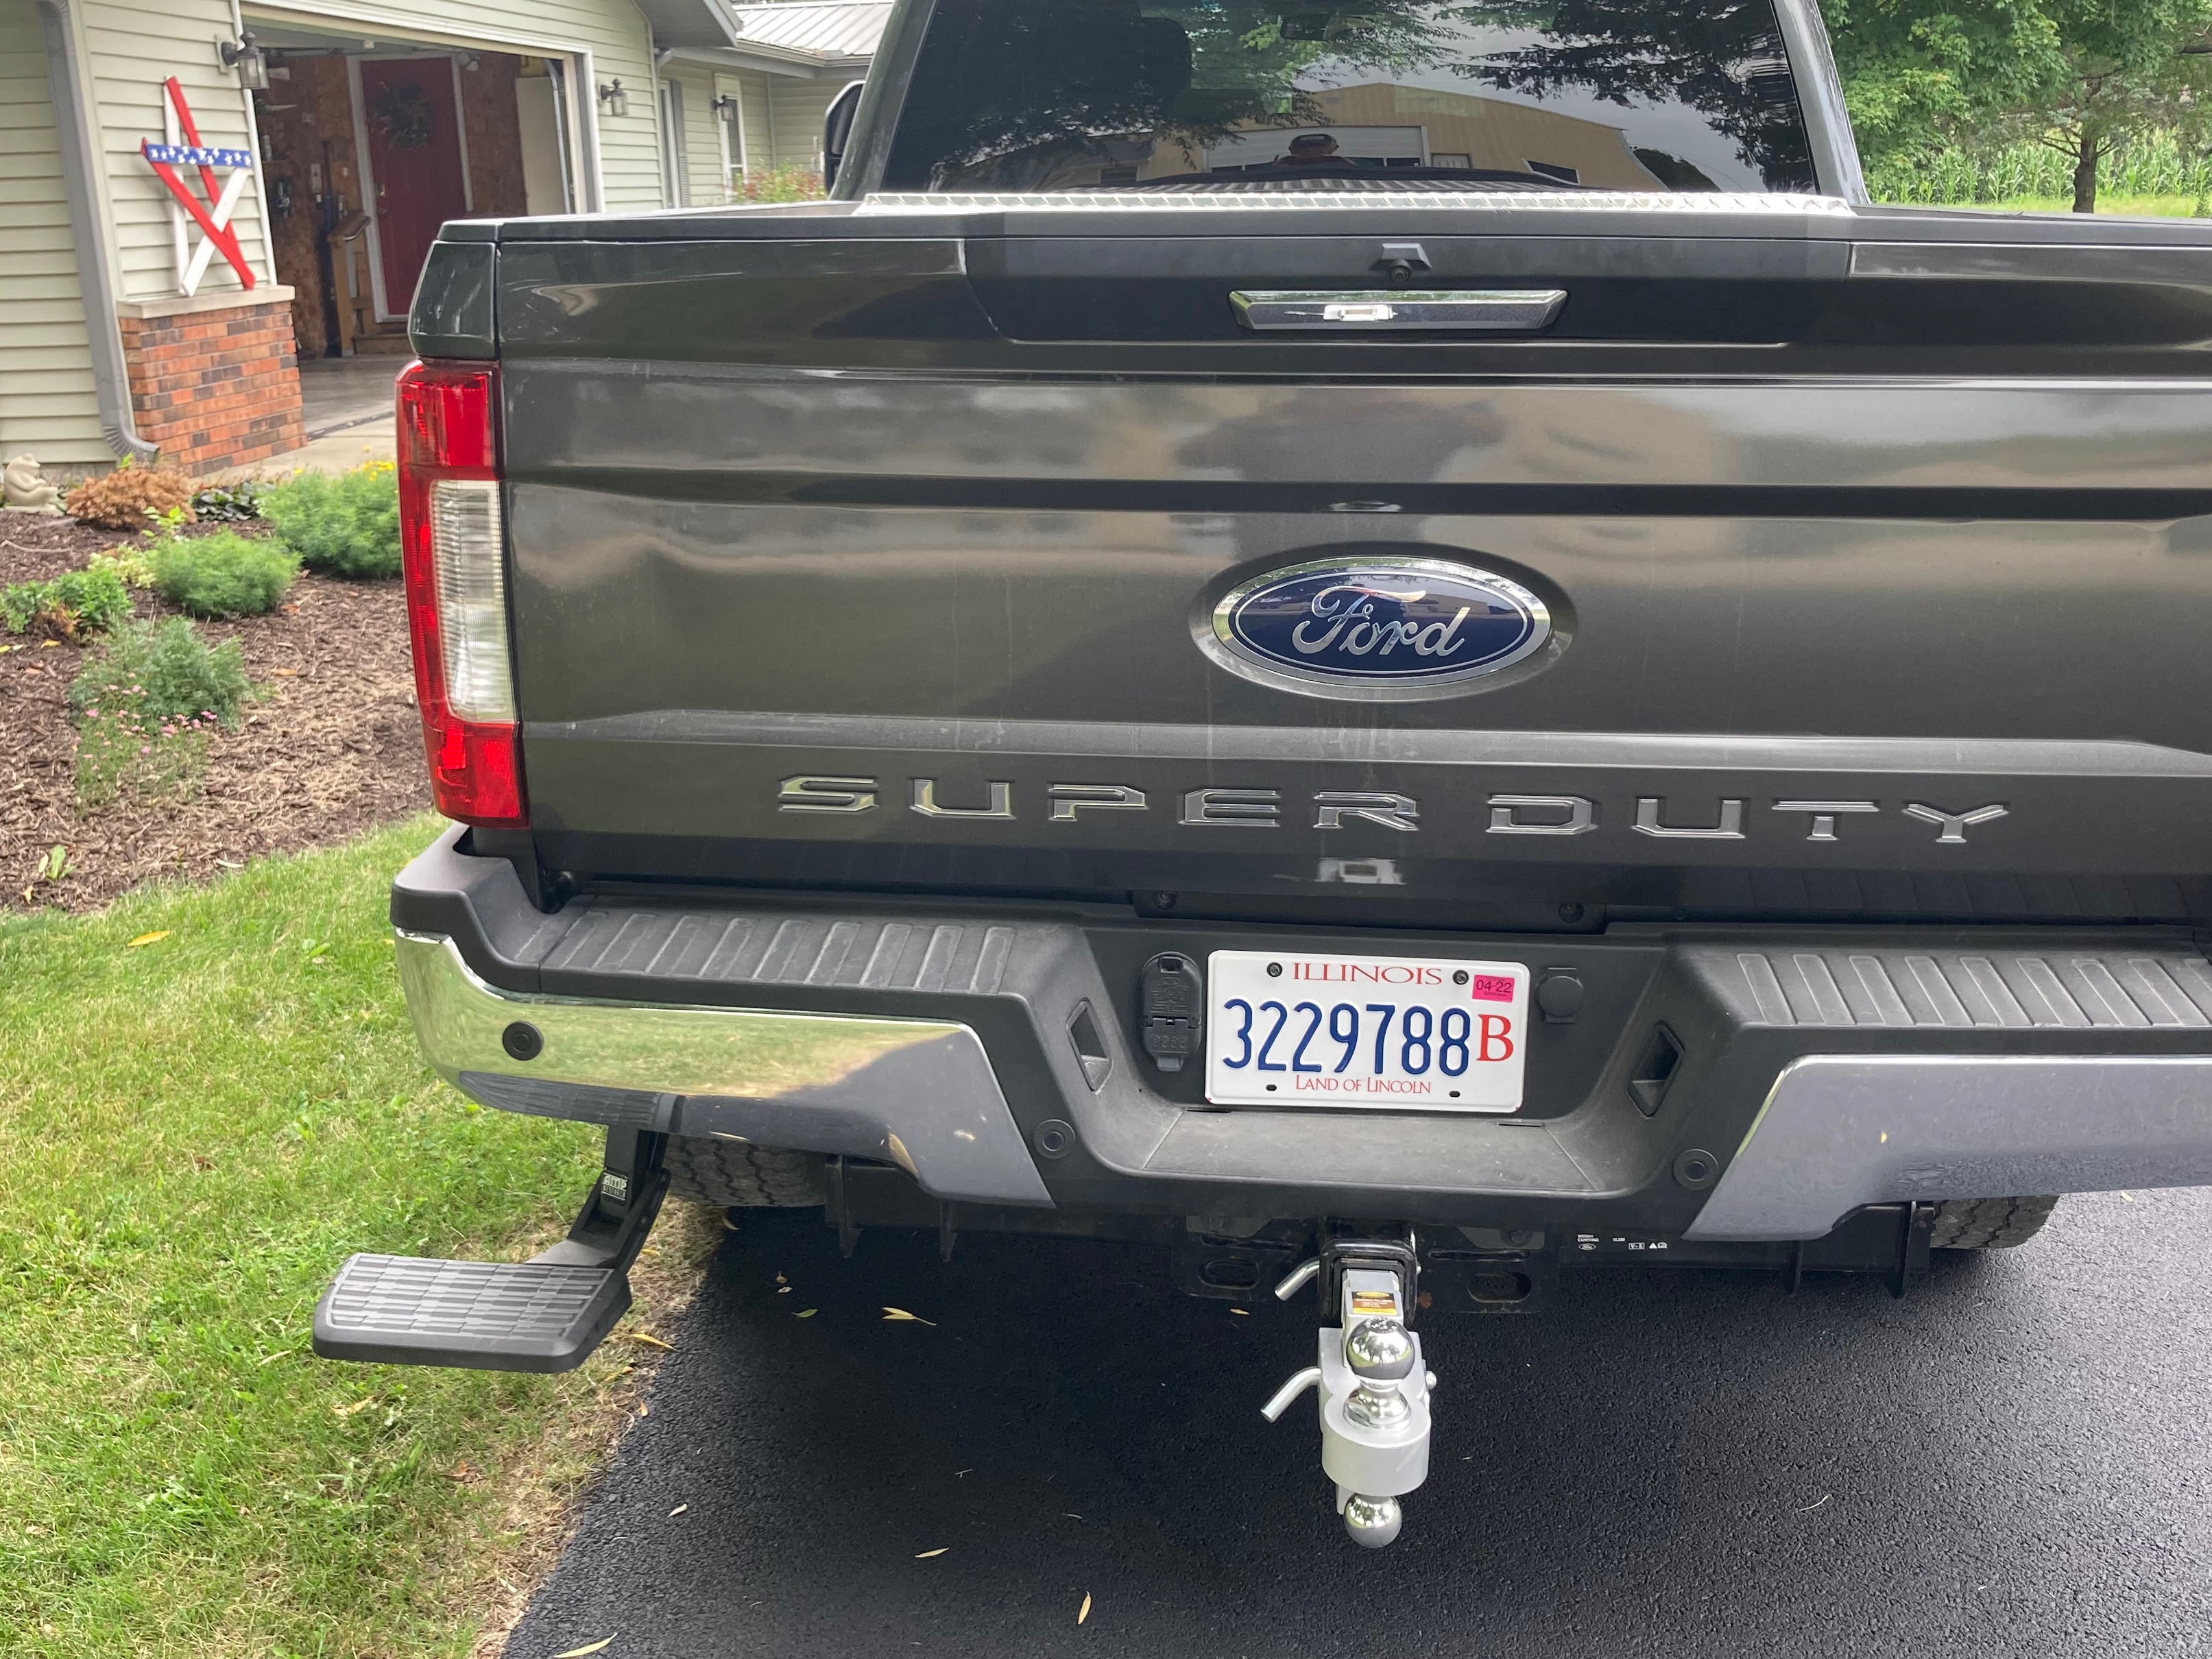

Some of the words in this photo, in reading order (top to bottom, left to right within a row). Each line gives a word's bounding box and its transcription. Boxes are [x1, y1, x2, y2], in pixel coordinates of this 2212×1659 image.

[1291, 585, 1471, 657] Ford
[778, 775, 1420, 831] SUPER
[1485, 793, 2010, 844] DUTY
[1293, 962, 1442, 985] ILLINOIS
[1476, 979, 1513, 993] 04-22
[1223, 998, 1471, 1076] 3229788
[1476, 1013, 1514, 1062] B
[1295, 1074, 1338, 1091] LAND
[1367, 1077, 1432, 1094] LINCOLN
